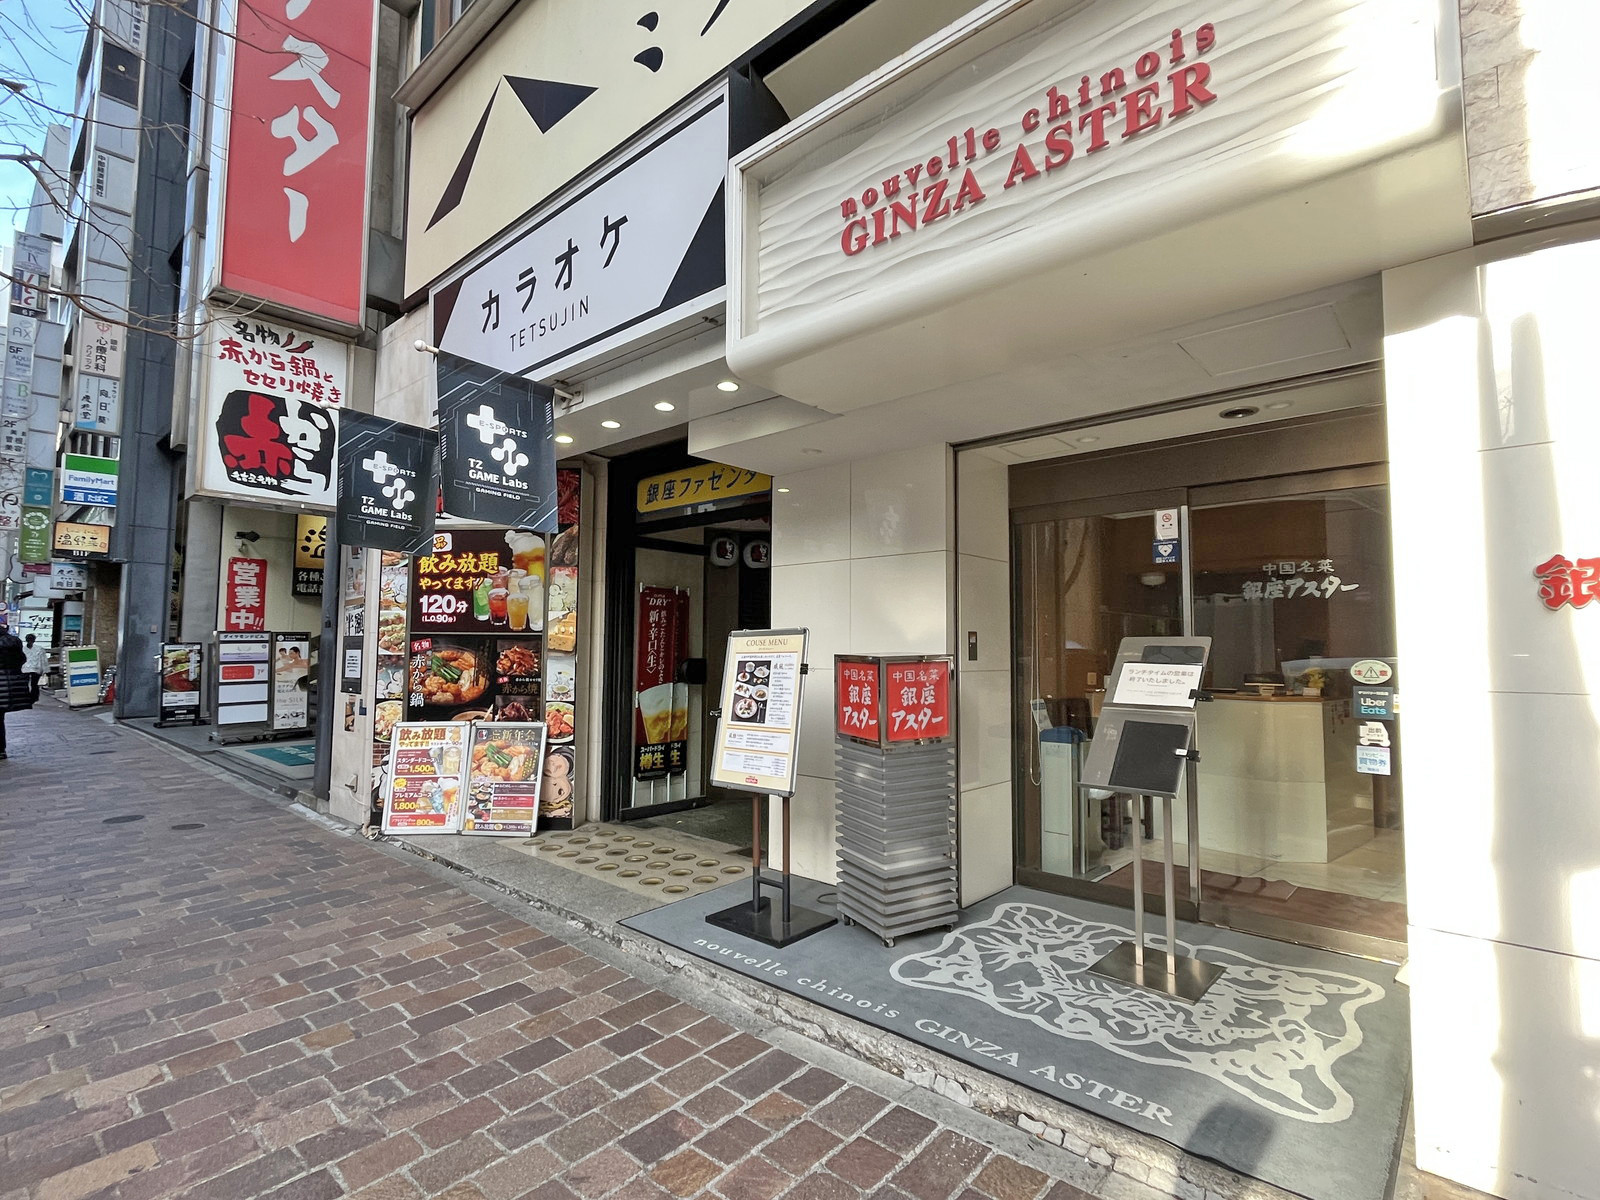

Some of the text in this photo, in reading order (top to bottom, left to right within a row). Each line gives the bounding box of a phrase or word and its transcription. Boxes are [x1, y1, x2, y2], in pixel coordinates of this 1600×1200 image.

[268, 0, 341, 243] スター
[840, 22, 1216, 219] nouvelle chinois
[840, 62, 1218, 257] GINZA ASTER
[481, 214, 629, 334] カラオケ
[232, 318, 281, 346] 名物
[509, 295, 591, 352] TETSUJIN
[219, 336, 334, 384] 赤から鍋と
[479, 419, 528, 438] E-SPORTS
[373, 463, 417, 478] E-SPORTS
[468, 457, 483, 470] TZ
[68, 474, 115, 486] FamilyMart
[469, 469, 528, 490] GAME Labs
[361, 496, 375, 505] TZ
[475, 487, 521, 501] GAMING FIELD
[361, 505, 413, 521] GAME Labs
[366, 520, 389, 528] GAMING
[418, 552, 499, 575] 飲み放題
[1262, 558, 1335, 576] 中国名菜
[1242, 575, 1360, 599] 銀座アスター
[419, 594, 468, 614] 120分
[746, 637, 788, 647] COUSE MENU
[409, 654, 426, 708] 赤から鍋
[843, 668, 875, 682] 中国名菜
[892, 668, 940, 683] 中国名菜
[1128, 669, 1194, 677] ランチタイムの営業は
[848, 682, 872, 705] 銀座
[900, 682, 936, 706] 銀座
[1360, 697, 1387, 707] Uber
[843, 705, 878, 730] アスター
[891, 706, 944, 733] アスター
[1360, 706, 1387, 715] Eats
[399, 728, 446, 741] 飲み放題
[693, 934, 900, 1020] nouvelle chinois
[914, 1017, 1174, 1127] GINZA ASTER
